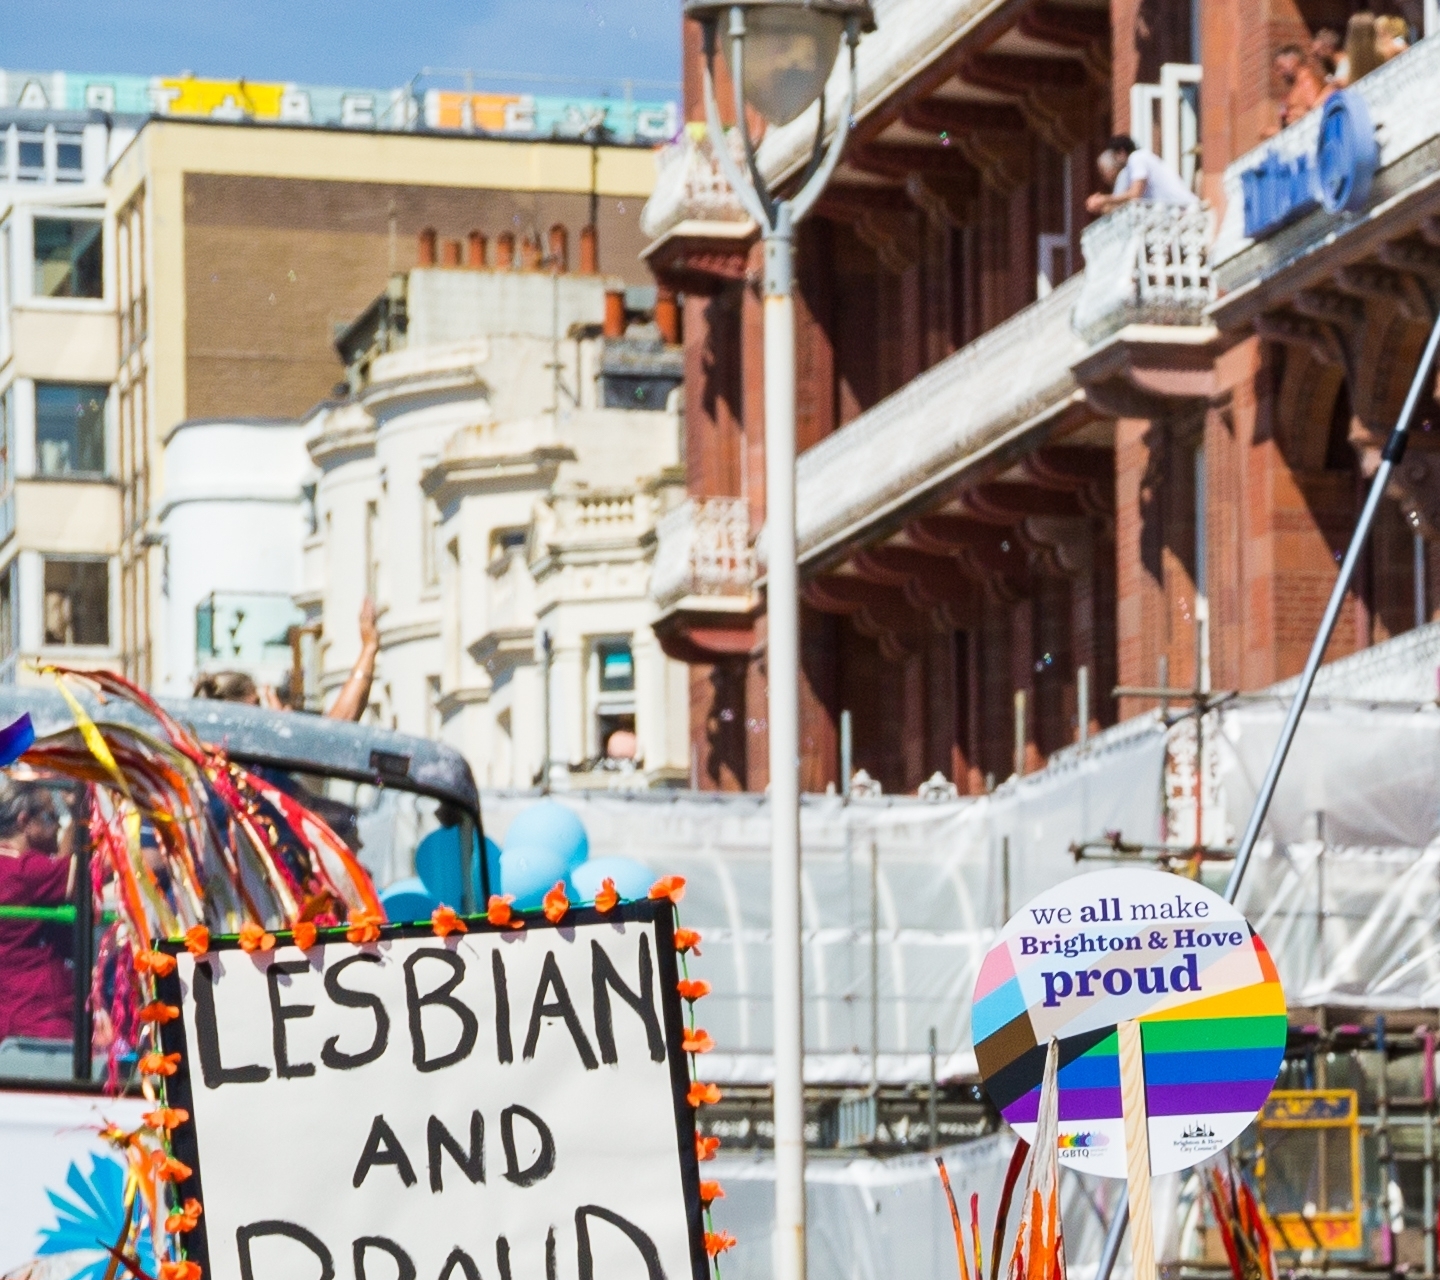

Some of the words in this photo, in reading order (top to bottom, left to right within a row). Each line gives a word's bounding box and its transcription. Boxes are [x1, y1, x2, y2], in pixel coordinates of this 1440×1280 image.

[1030, 906, 1072, 925] we
[1079, 898, 1123, 923] all
[1130, 895, 1209, 921] make
[1020, 932, 1142, 958] Brighton
[1147, 931, 1168, 949] &
[1173, 929, 1243, 949] Hove
[1041, 953, 1202, 1008] proud
[193, 931, 666, 1089] LESBIAN
[352, 1103, 556, 1194] AND
